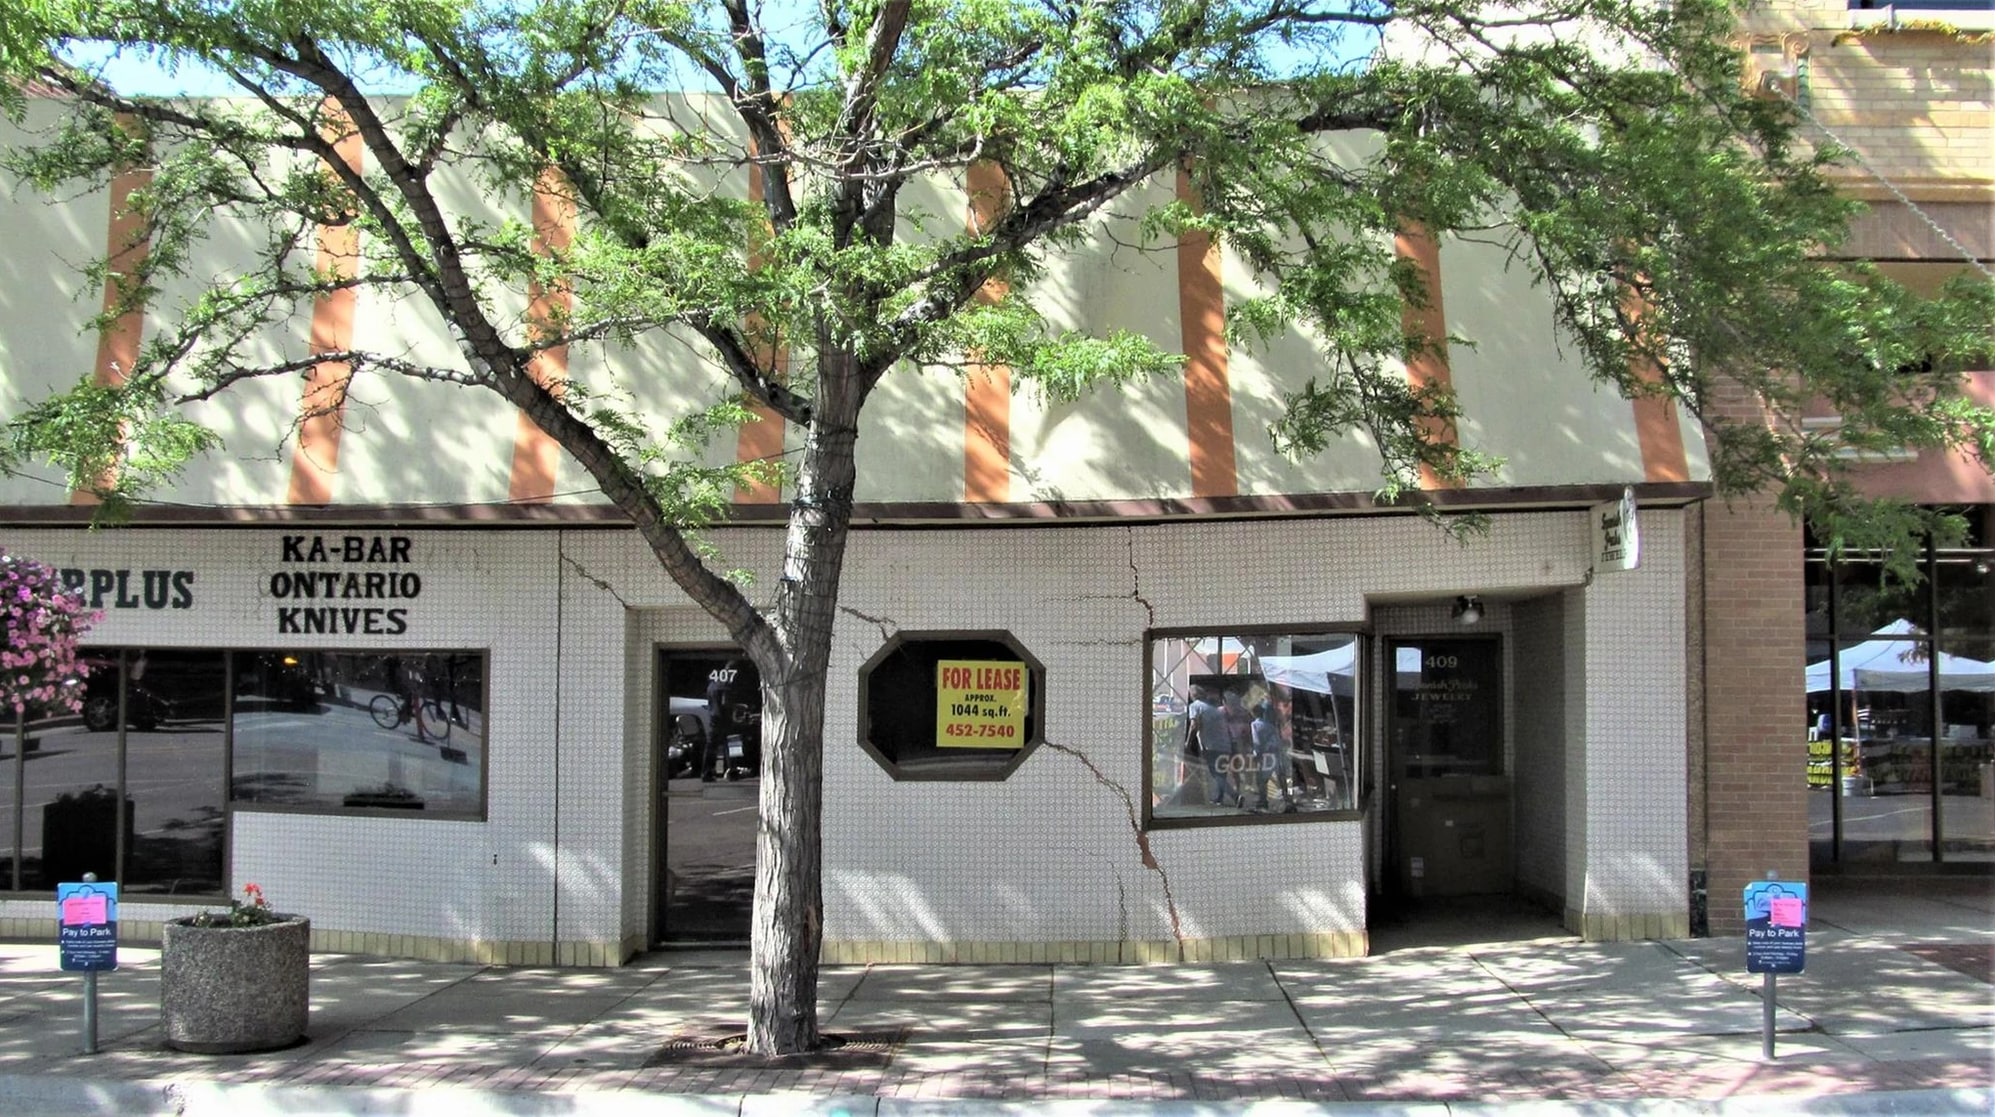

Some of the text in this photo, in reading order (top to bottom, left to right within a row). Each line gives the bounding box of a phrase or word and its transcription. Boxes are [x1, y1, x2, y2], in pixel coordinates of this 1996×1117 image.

[282, 536, 411, 563] KA-BAR
[53, 569, 194, 609] RPLUS
[270, 572, 421, 599] ONTARIO
[278, 607, 408, 635] KNIVES
[1425, 655, 1458, 669] 409
[709, 669, 738, 683] 407
[942, 667, 1021, 690] FOR LEASE
[965, 694, 997, 702] APPROX.
[951, 704, 1011, 719] 1044 sq.ft.
[946, 724, 1015, 737] 452-7540
[1214, 753, 1277, 774] GOLD
[62, 928, 112, 938] Pay to Park
[1749, 929, 1800, 939] Pay to Park
